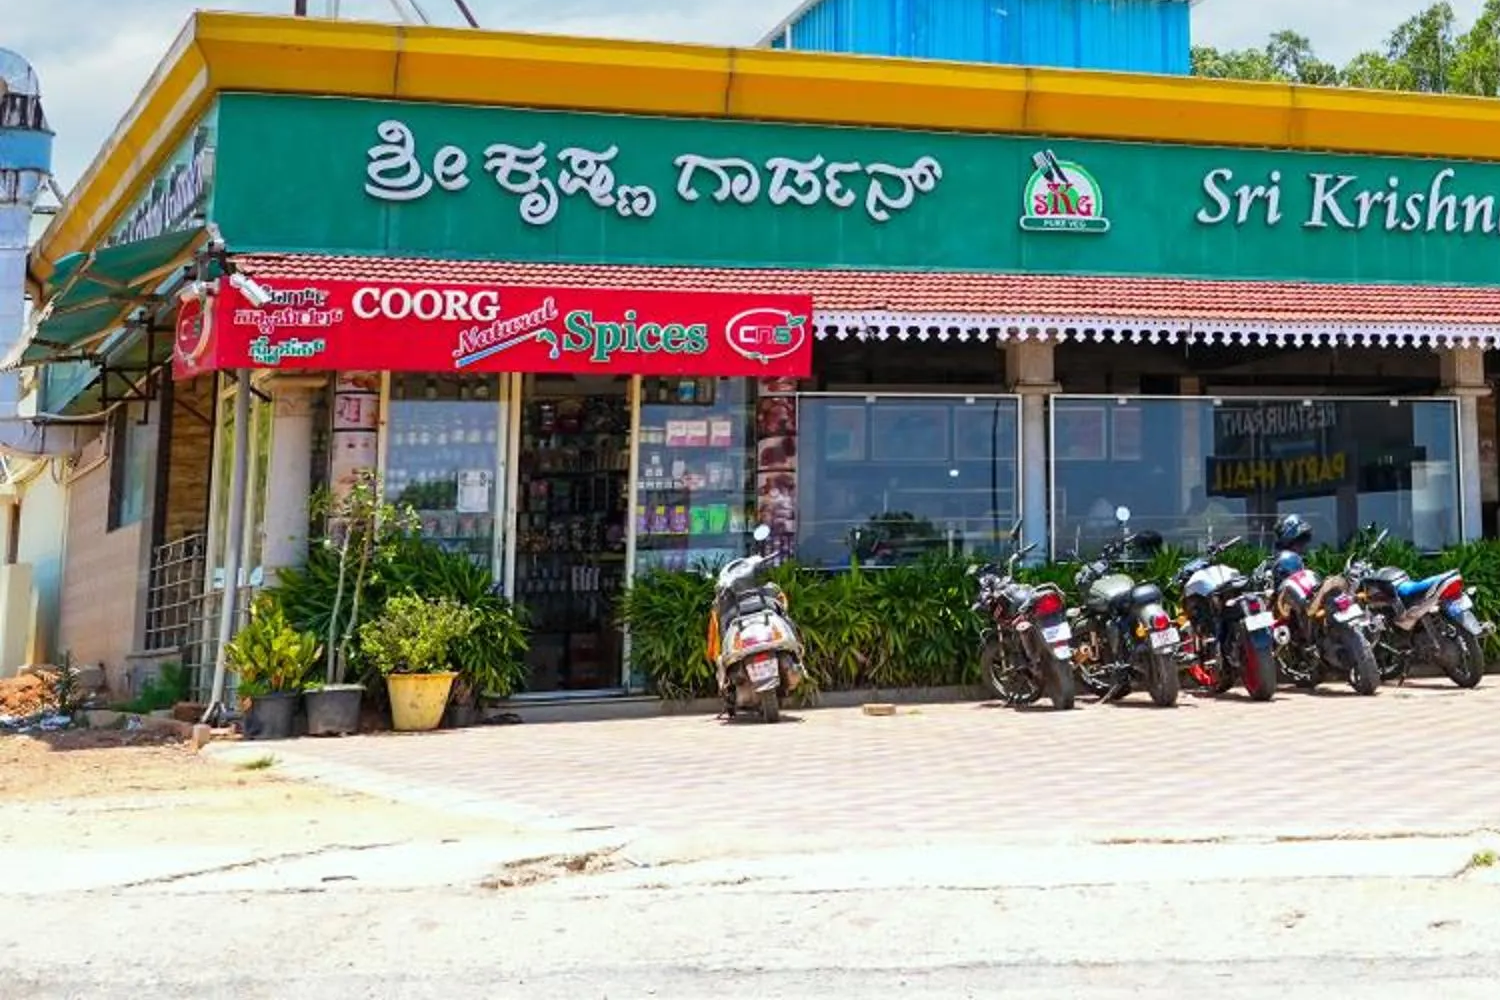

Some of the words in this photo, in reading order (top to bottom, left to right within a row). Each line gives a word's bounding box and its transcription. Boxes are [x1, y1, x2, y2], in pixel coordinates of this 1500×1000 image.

[365, 120, 470, 201] ಶ್ರೀ
[484, 141, 657, 225] ಕೃಷ್ಣ
[673, 154, 943, 221] ಗಾರ್ಡನ್
[1197, 168, 1282, 226] Sri
[352, 287, 500, 321] COORG
[452, 296, 559, 356] Natural
[563, 310, 708, 363] Spices
